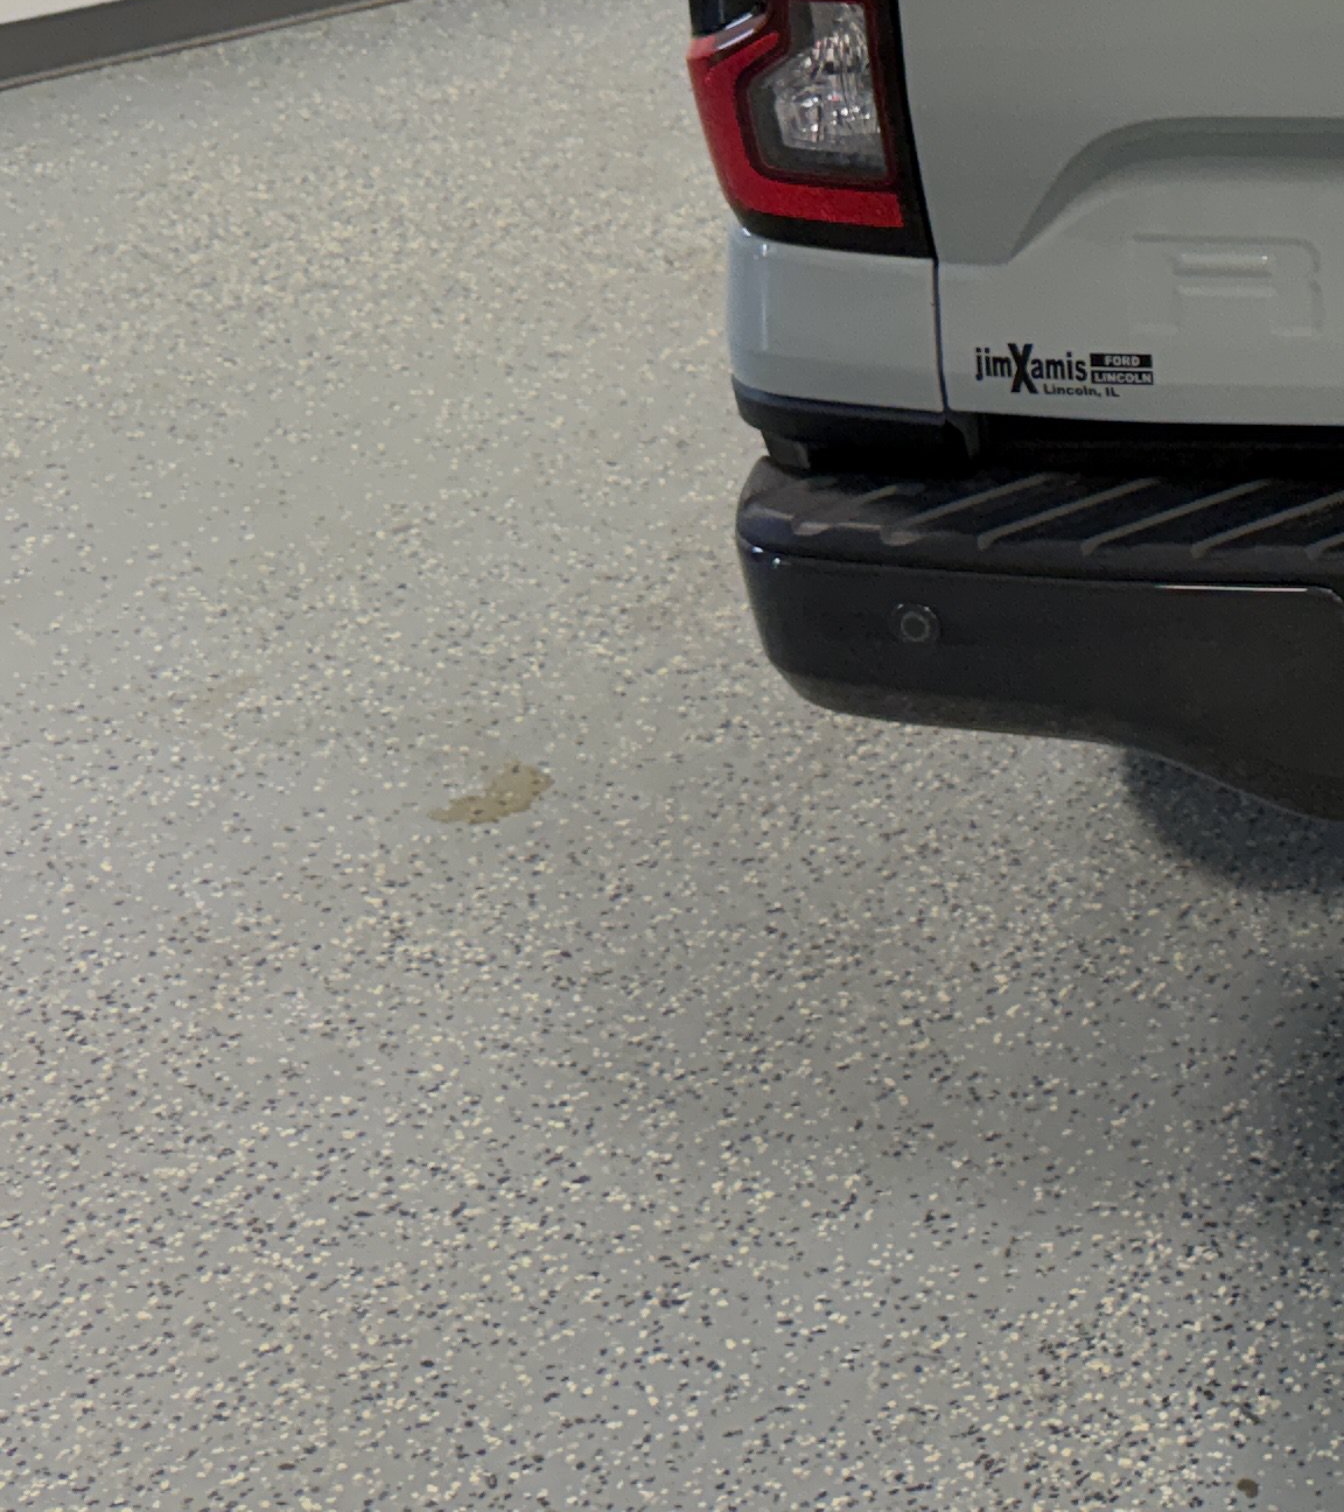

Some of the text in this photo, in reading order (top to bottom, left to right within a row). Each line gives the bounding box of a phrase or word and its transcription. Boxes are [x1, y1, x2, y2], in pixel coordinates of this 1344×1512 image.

[1103, 354, 1141, 366] FORD
[1093, 371, 1152, 384] LINCOLN
[1043, 383, 1120, 397] Lincoln, IL
